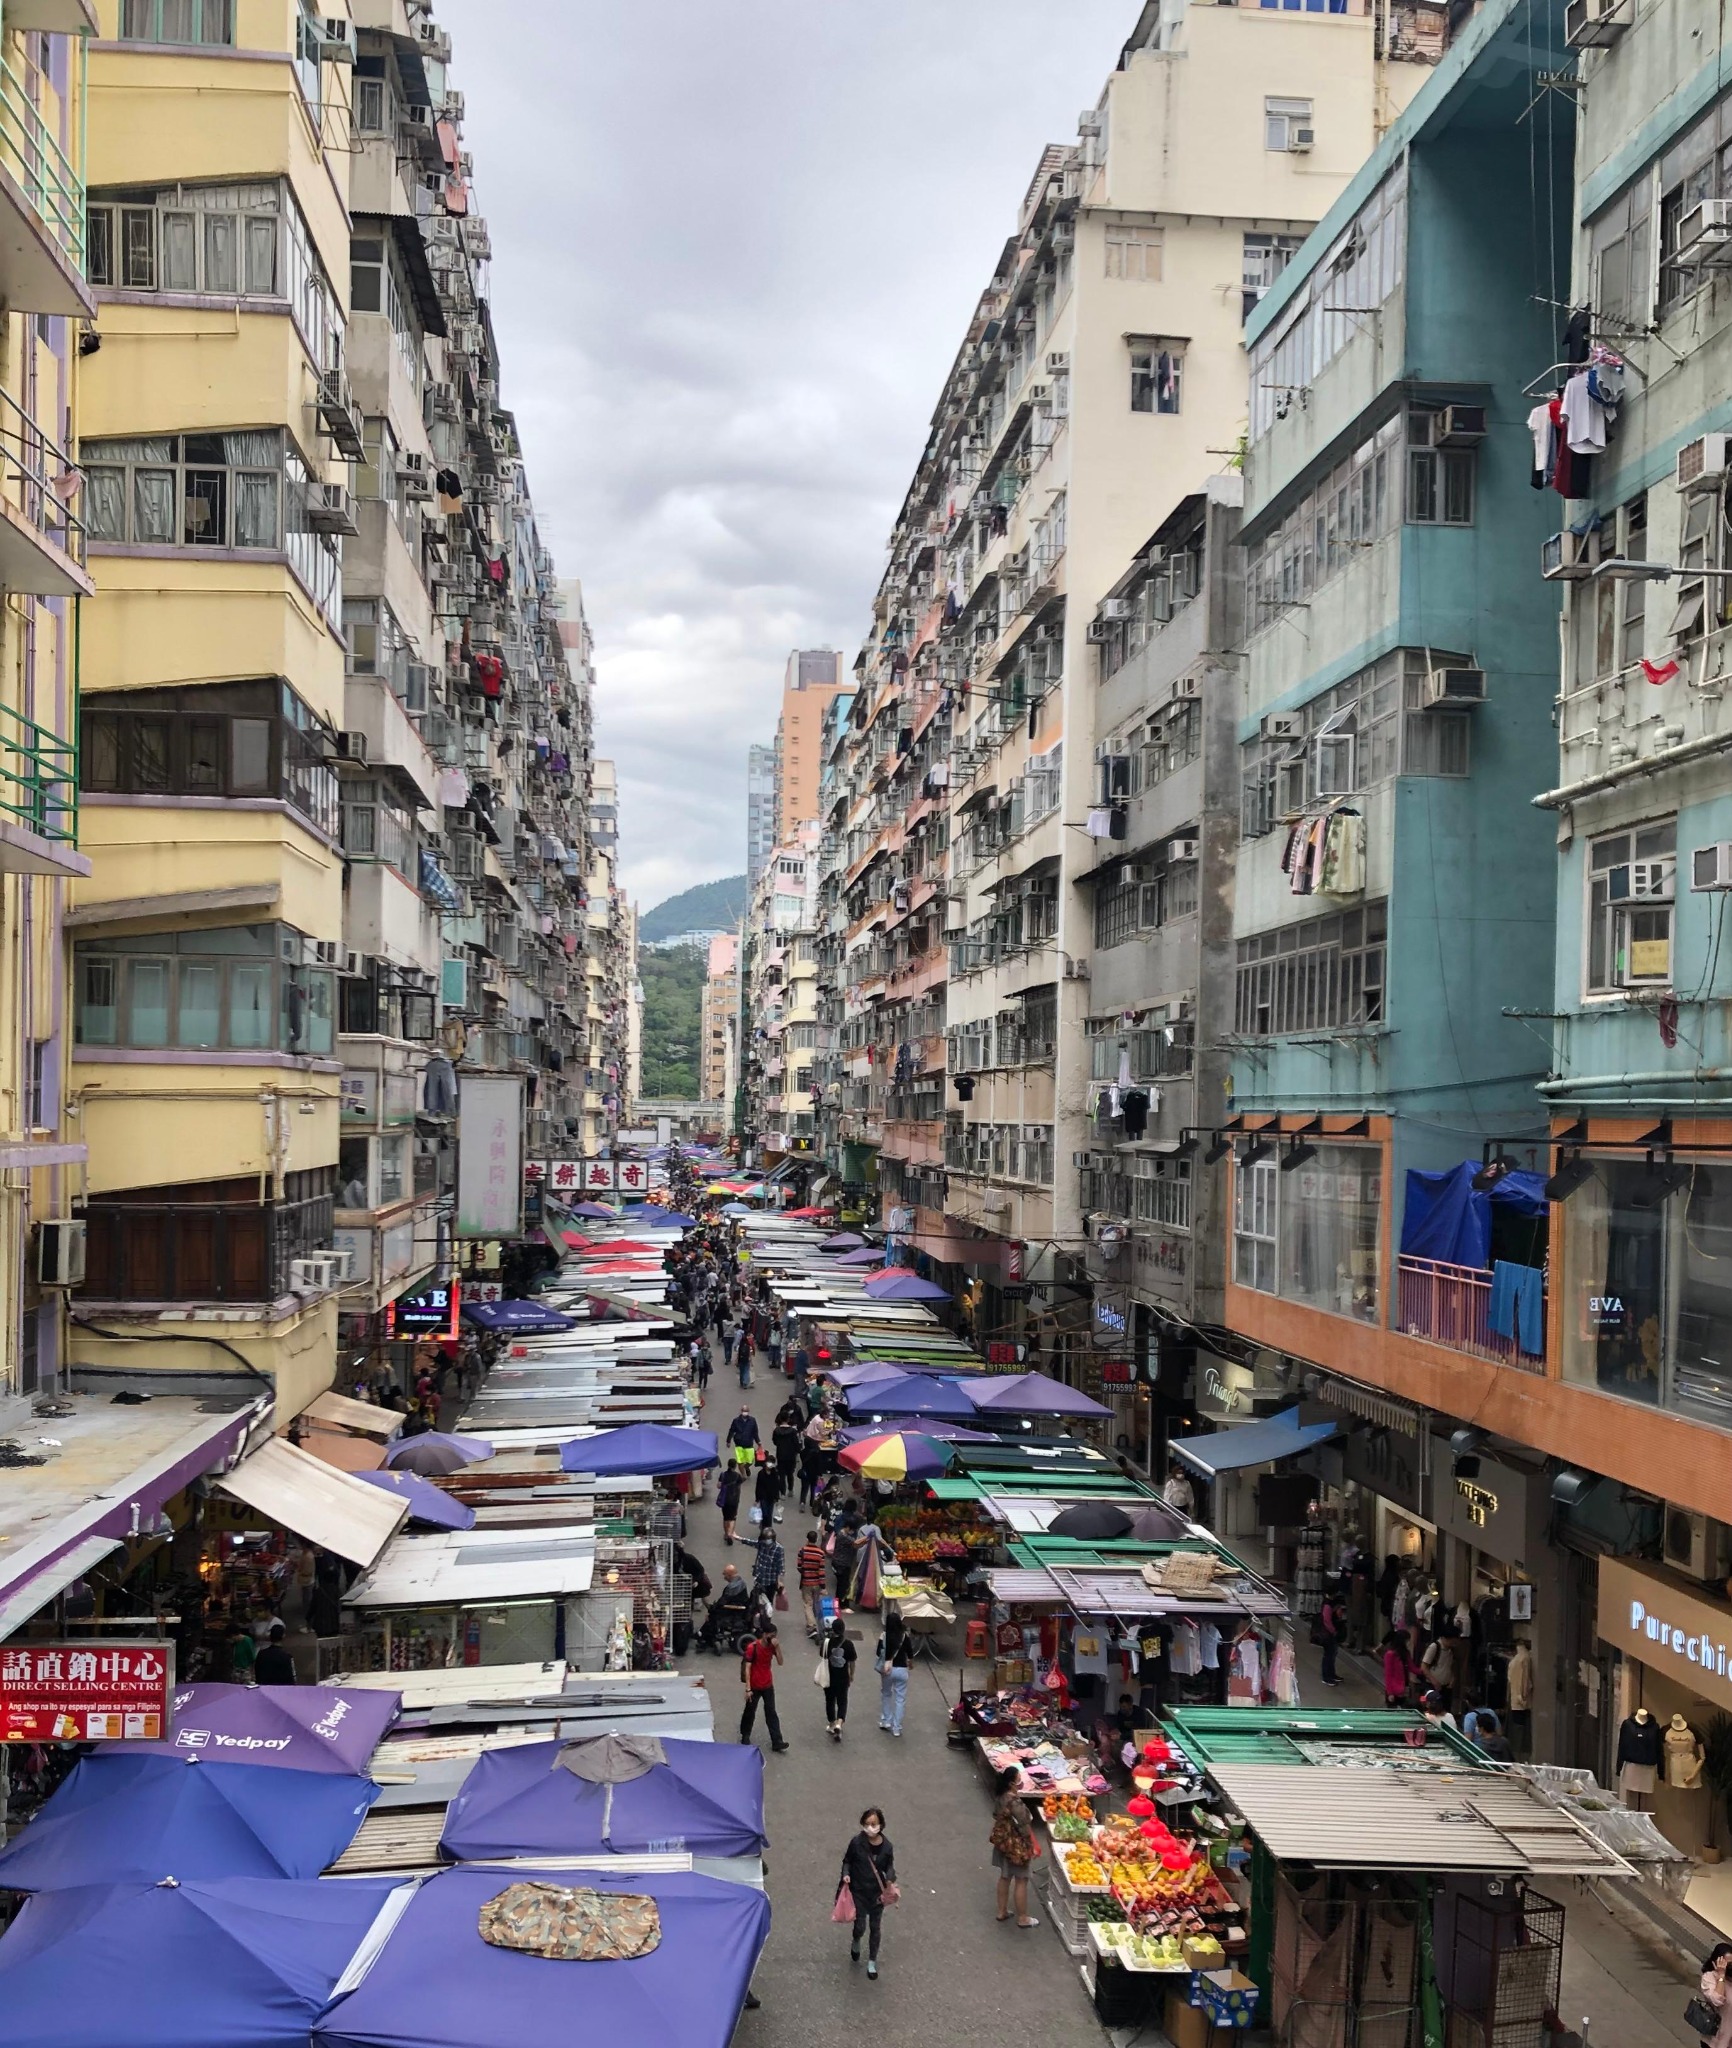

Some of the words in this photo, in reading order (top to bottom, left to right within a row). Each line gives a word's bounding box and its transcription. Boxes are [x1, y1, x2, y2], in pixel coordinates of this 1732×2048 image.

[1103, 1383, 1137, 1392] 91755993
[2, 1651, 163, 1681] 話直銷中心
[3, 1682, 51, 1691] DIRECT
[53, 1682, 109, 1691] SELLING
[111, 1682, 163, 1691] CENTRE
[8, 1702, 22, 1712] Ang
[23, 1702, 39, 1712] shop
[60, 1704, 67, 1712] ay
[68, 1703, 96, 1712] espesyal
[97, 1704, 111, 1712] para
[122, 1704, 136, 1712] mga
[137, 1702, 161, 1712] Filipino
[321, 1699, 352, 1728] Yedpay
[214, 1734, 291, 1751] Yedpay
